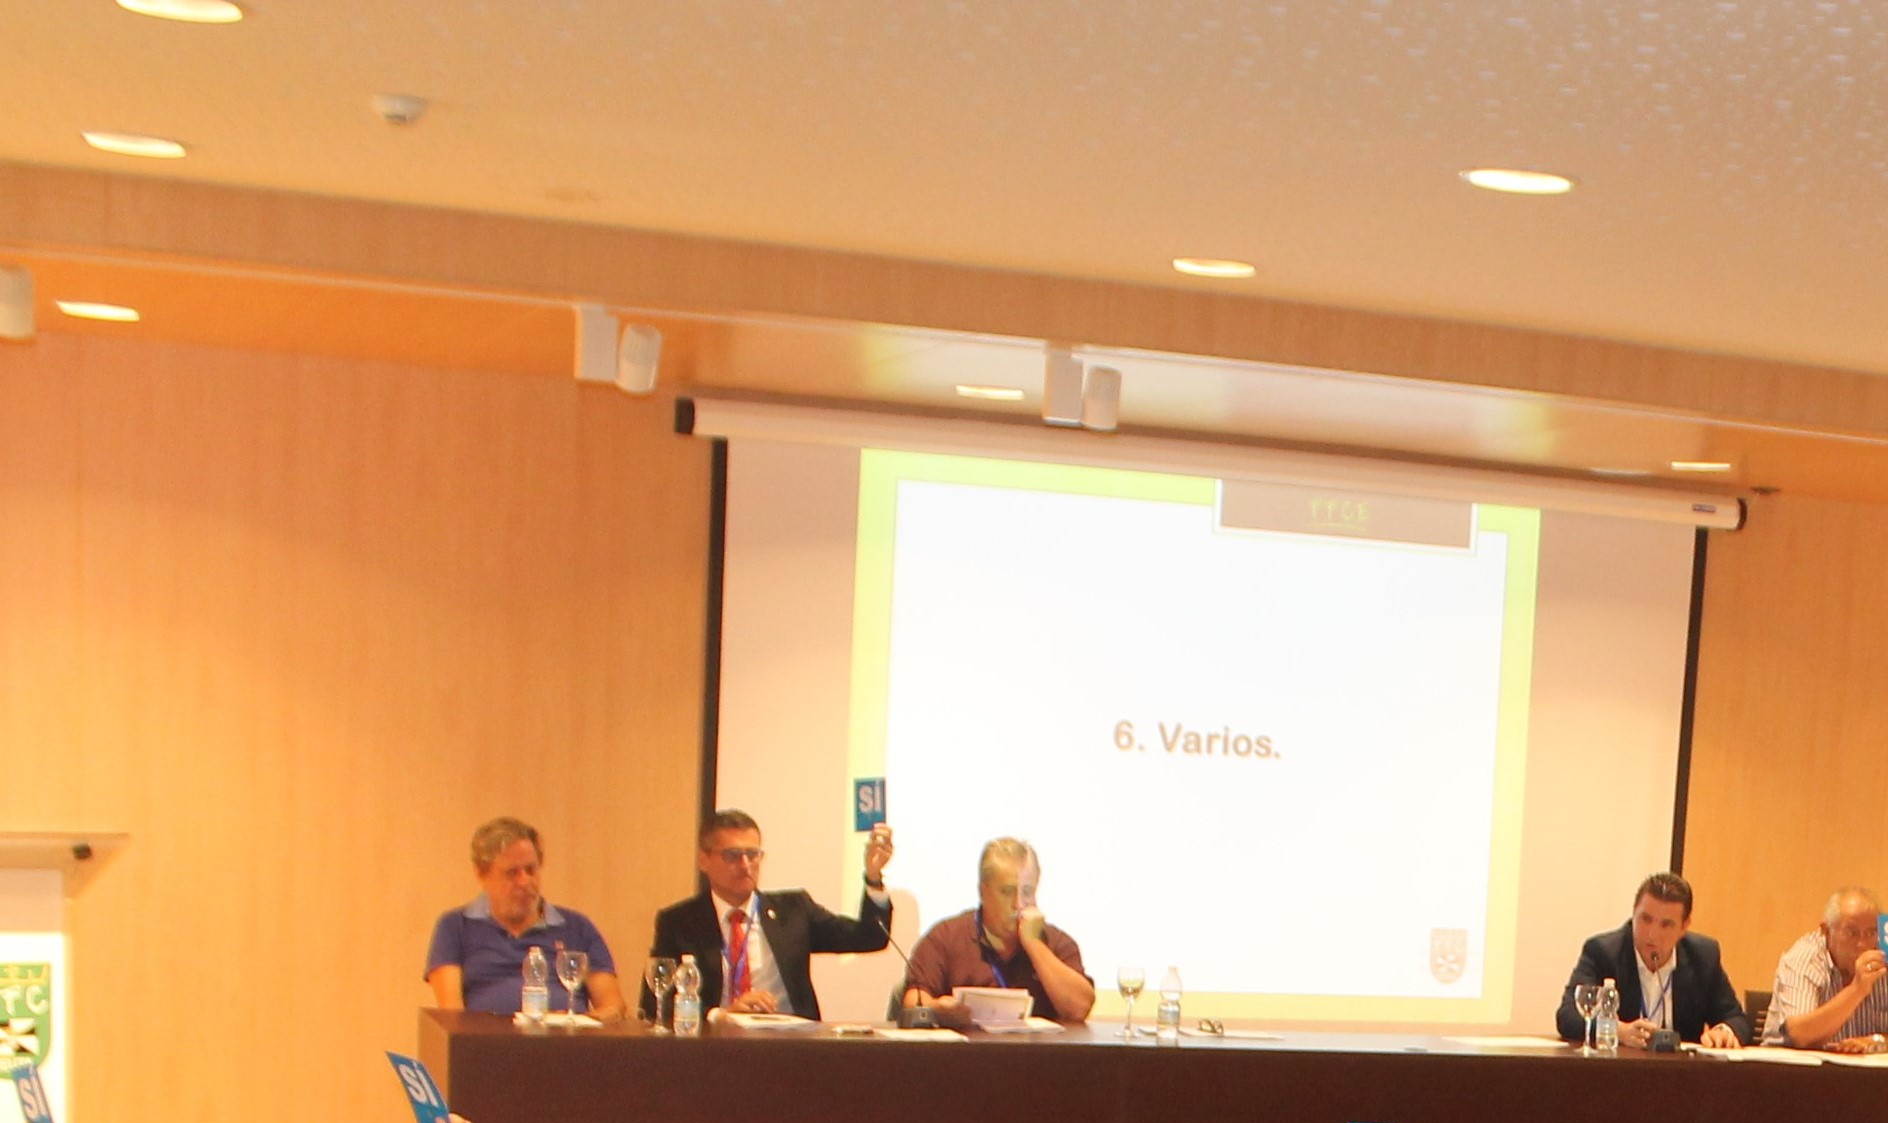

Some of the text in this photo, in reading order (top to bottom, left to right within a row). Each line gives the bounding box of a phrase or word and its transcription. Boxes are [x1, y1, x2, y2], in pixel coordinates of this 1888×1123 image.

[1113, 719, 1282, 760] 6. Varios.
[18, 1064, 47, 1121] SÍ
[398, 1061, 440, 1108] SÍ
